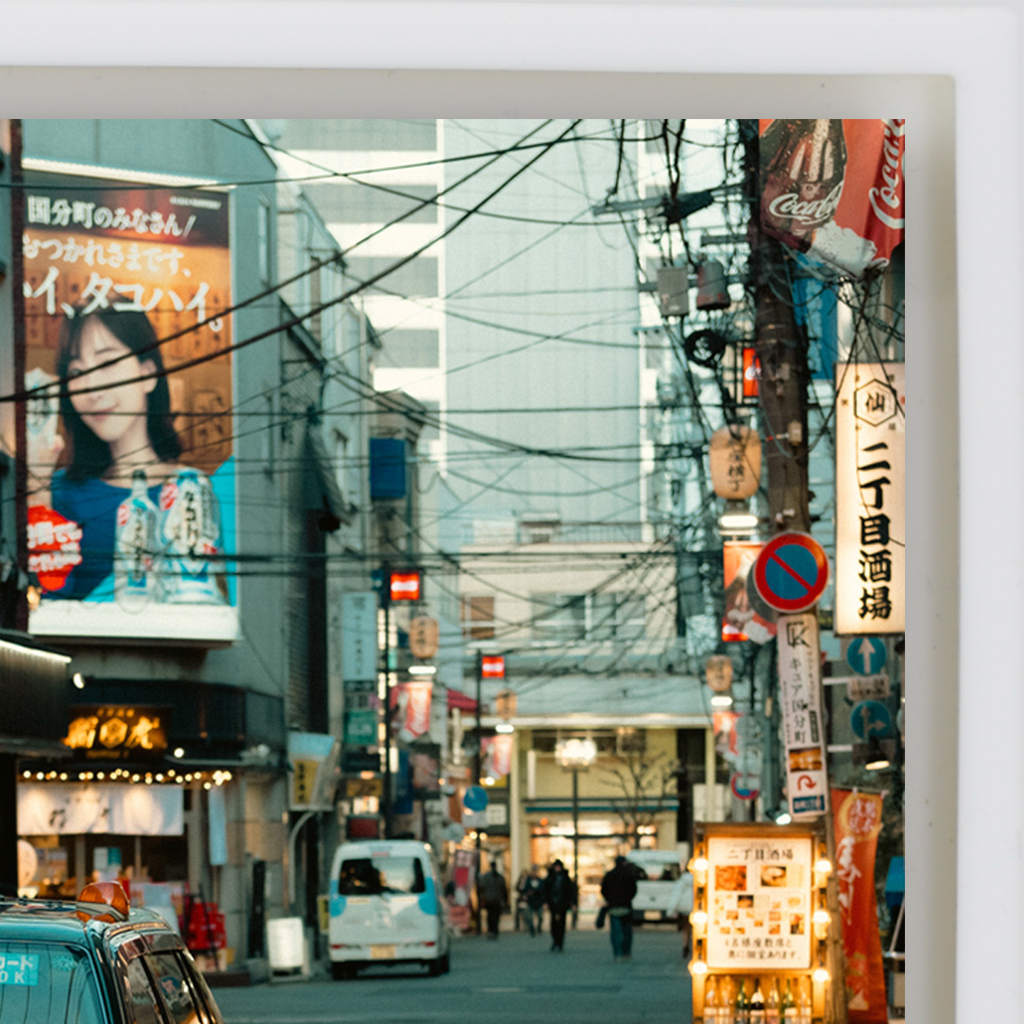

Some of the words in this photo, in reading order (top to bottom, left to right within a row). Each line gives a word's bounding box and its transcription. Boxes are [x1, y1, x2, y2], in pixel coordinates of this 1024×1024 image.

[858, 441, 893, 620] 二丁目酒場
